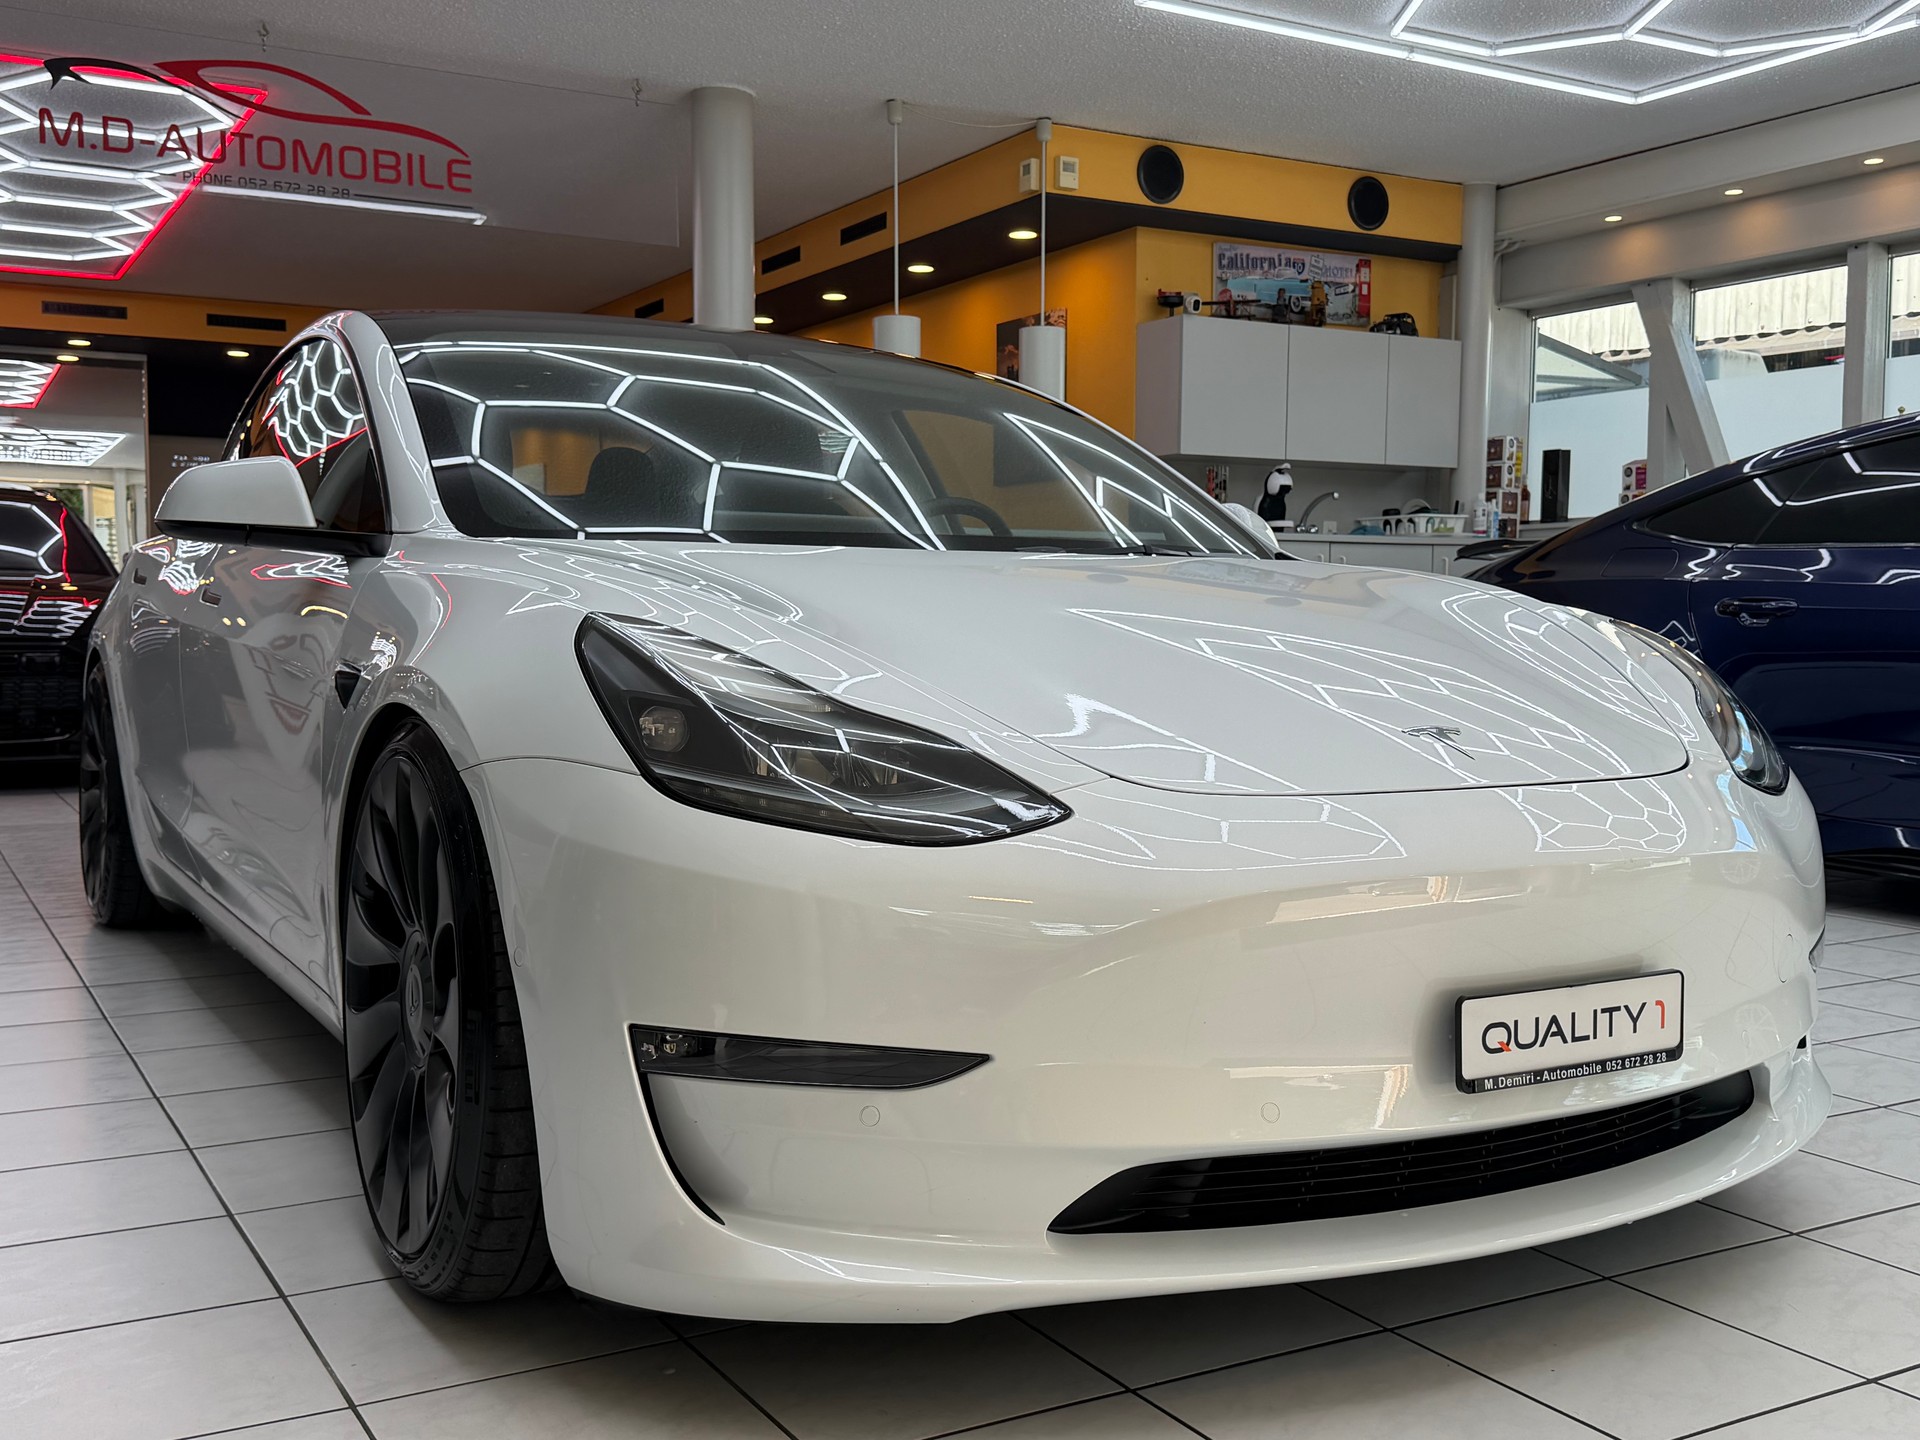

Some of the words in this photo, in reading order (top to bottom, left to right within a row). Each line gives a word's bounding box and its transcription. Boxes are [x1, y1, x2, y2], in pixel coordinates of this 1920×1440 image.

[39, 107, 473, 194] M.D-AUTOMOBILE
[182, 171, 232, 186] PHONE
[238, 174, 268, 189] 052
[273, 181, 301, 193] 672
[307, 184, 326, 196] 28
[332, 187, 350, 199] 28
[1218, 252, 1293, 271] California
[1542, 1062, 1602, 1082] Automobile
[1606, 1060, 1623, 1072] 052
[1625, 1057, 1641, 1069] 672
[1643, 1054, 1654, 1065] 28
[1656, 1051, 1667, 1063] 28
